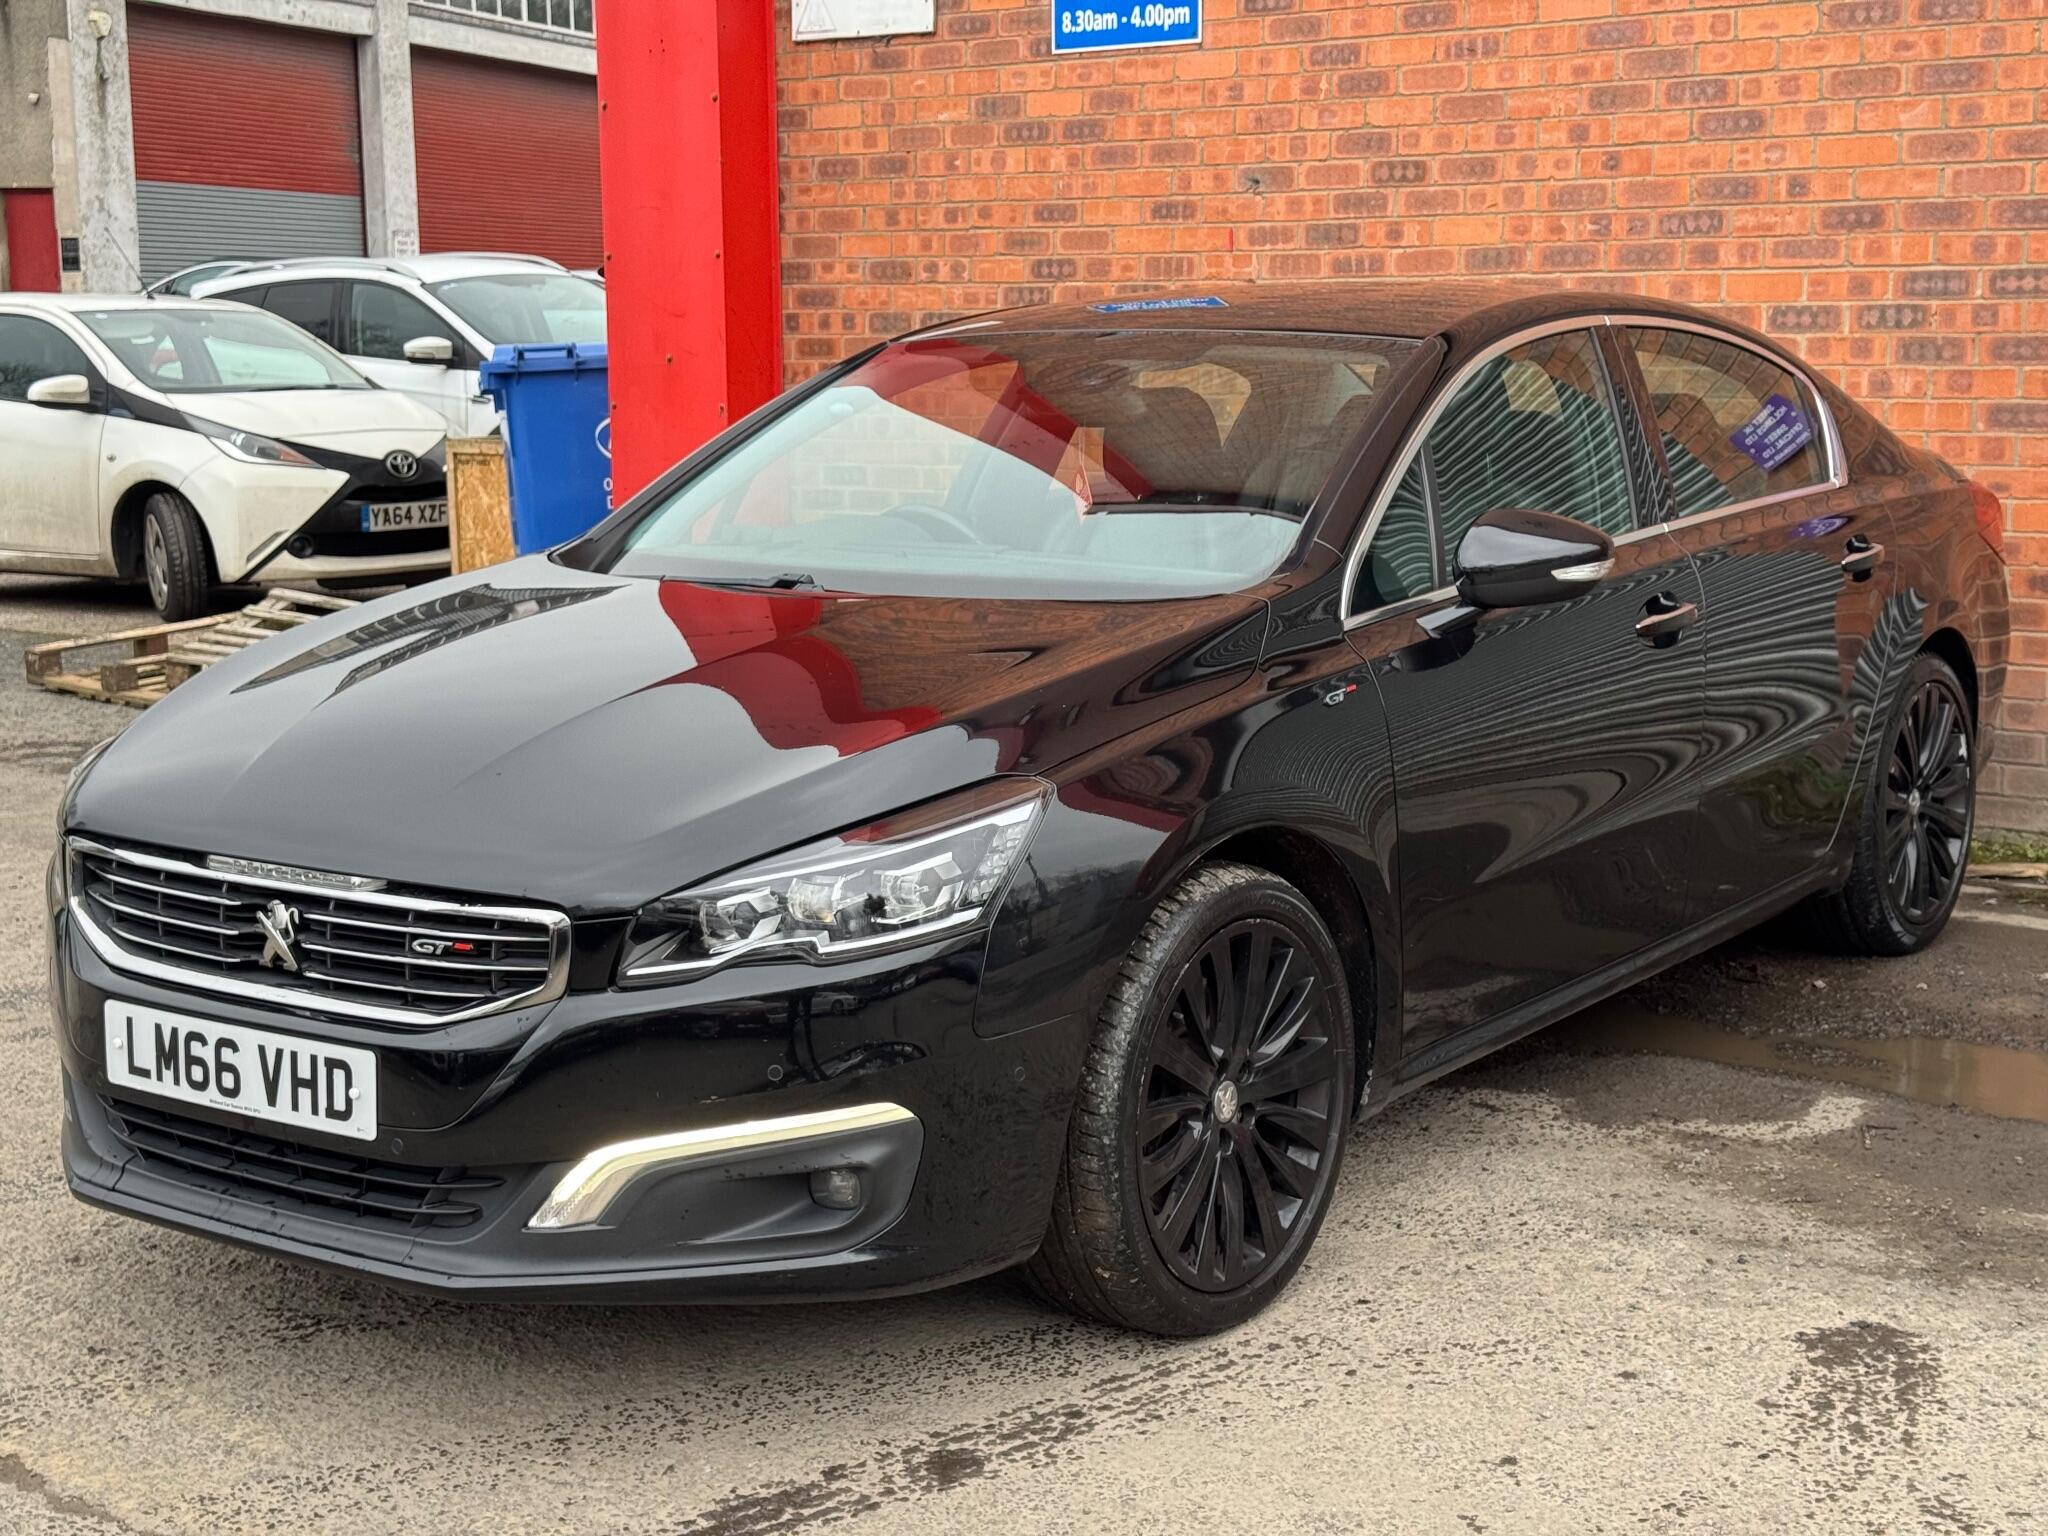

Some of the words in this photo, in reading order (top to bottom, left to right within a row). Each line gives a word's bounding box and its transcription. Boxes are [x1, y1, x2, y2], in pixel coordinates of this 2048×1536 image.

[1062, 9, 1118, 33] 8.30am
[1130, 3, 1191, 32] 4.00pm
[371, 505, 413, 527] YA64
[418, 503, 447, 523] XZF
[126, 1016, 241, 1099] LM66
[257, 1044, 354, 1122] VHD
